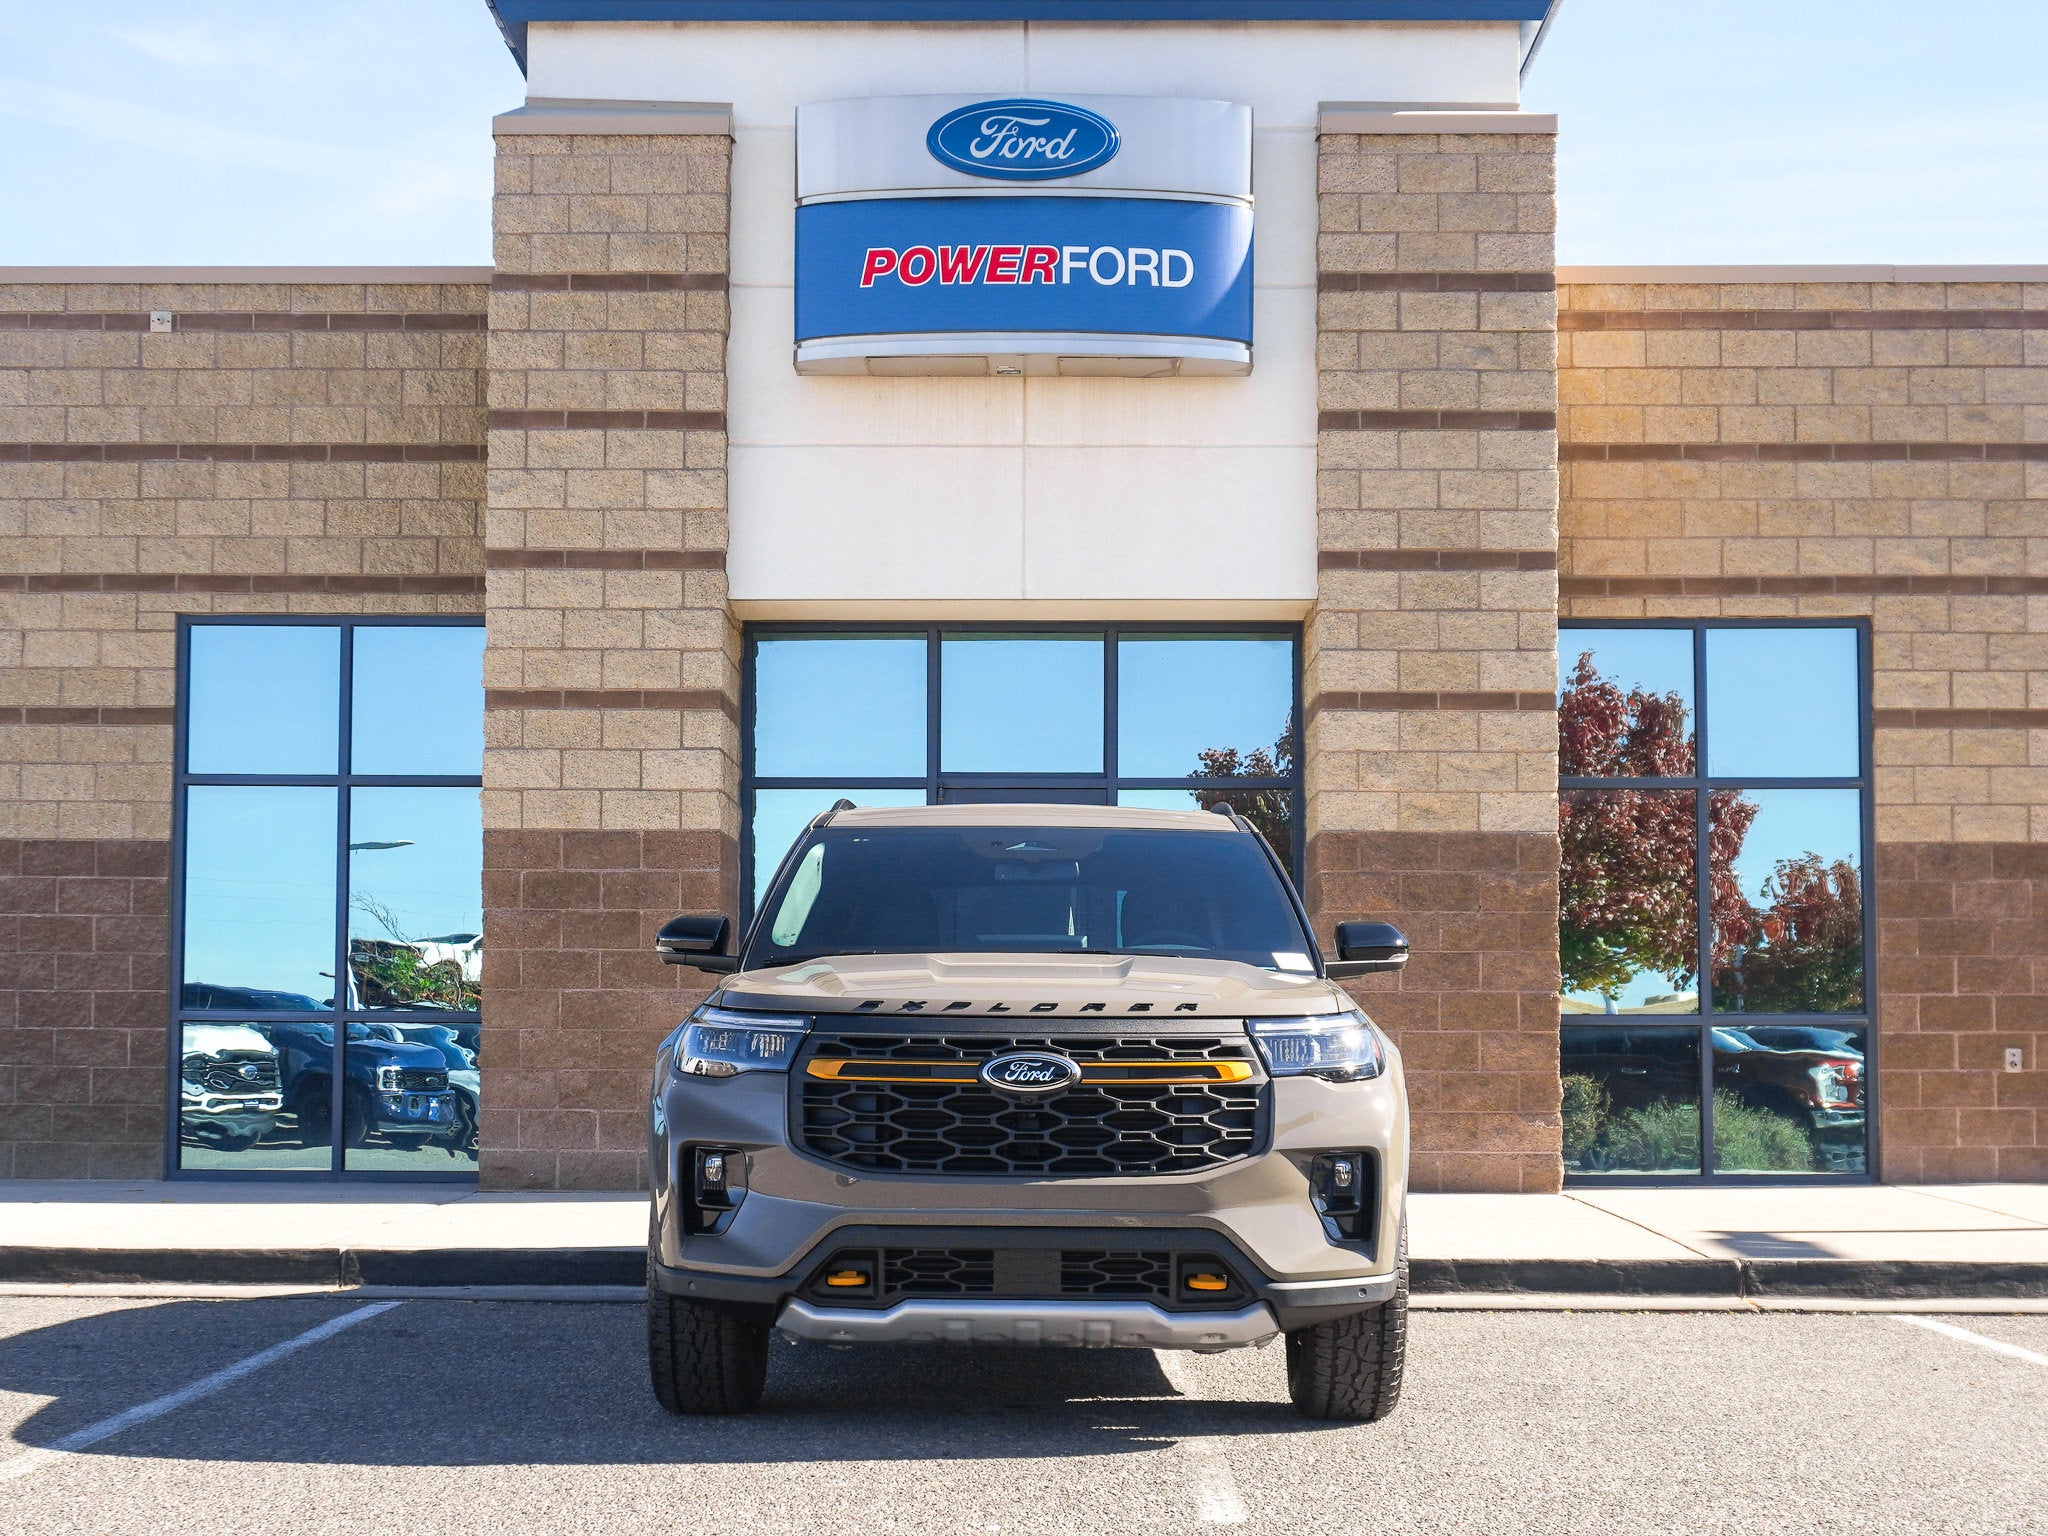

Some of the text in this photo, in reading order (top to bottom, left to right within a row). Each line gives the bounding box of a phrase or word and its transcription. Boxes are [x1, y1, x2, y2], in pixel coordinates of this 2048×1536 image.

[969, 115, 1077, 160] Ford
[852, 999, 1199, 1012] EXPLORER
[1004, 1061, 1054, 1082] Ford
